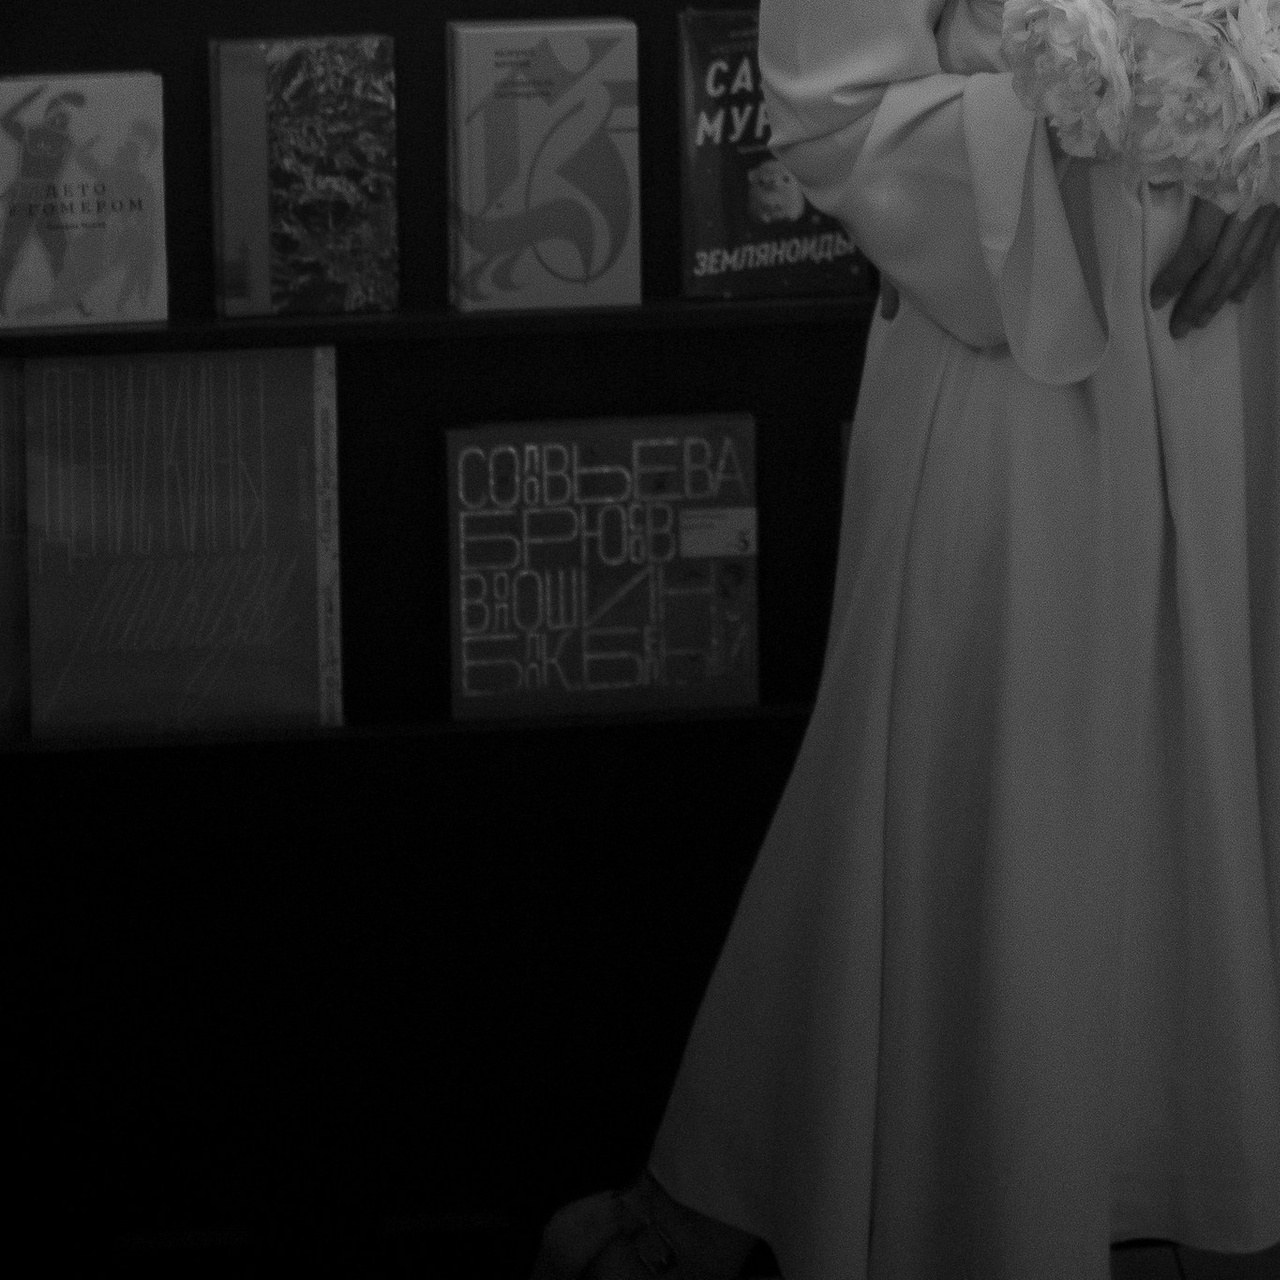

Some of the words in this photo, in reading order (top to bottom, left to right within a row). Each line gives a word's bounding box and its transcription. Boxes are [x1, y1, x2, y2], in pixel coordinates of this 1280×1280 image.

[704, 55, 764, 98] СА
[45, 182, 107, 200] ЛЕТО
[28, 197, 144, 220] ГОМЕРОМ
[693, 230, 858, 278] ЗЕМЛЯНОИДЫ
